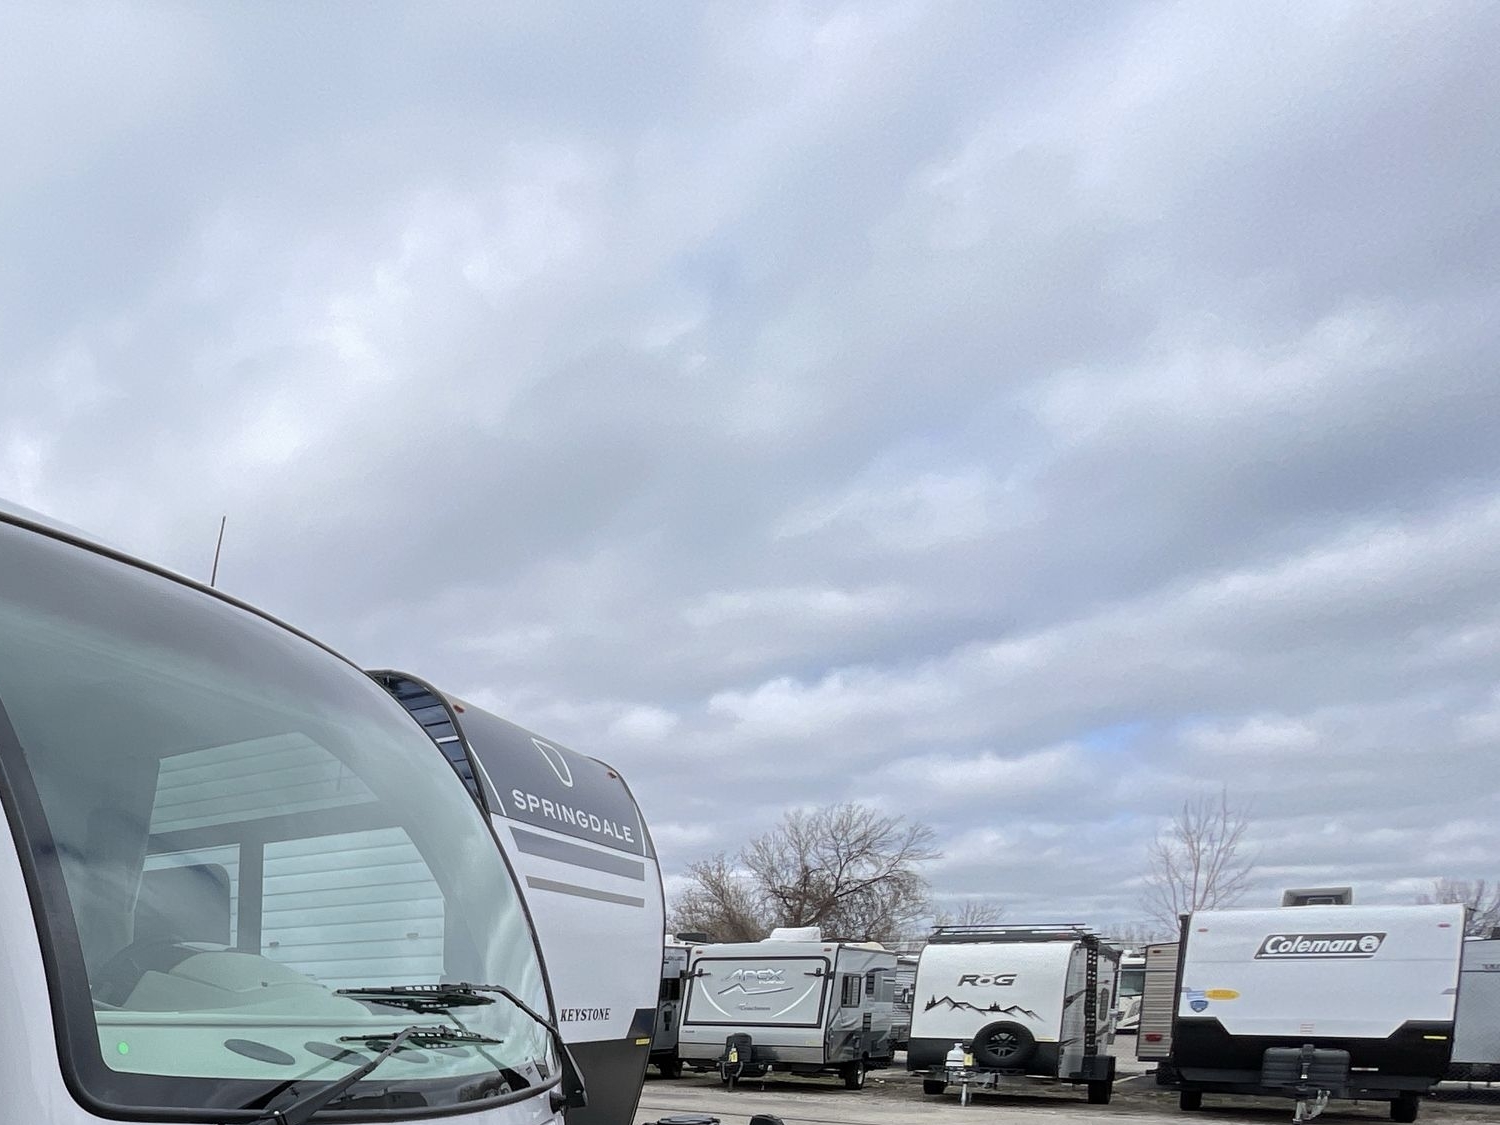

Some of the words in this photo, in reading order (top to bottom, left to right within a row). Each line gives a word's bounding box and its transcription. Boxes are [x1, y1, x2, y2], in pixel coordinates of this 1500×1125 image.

[511, 788, 635, 844] SPRINGDALE
[1264, 935, 1358, 954] Coleman
[560, 1007, 612, 1021] KEYSTONE
